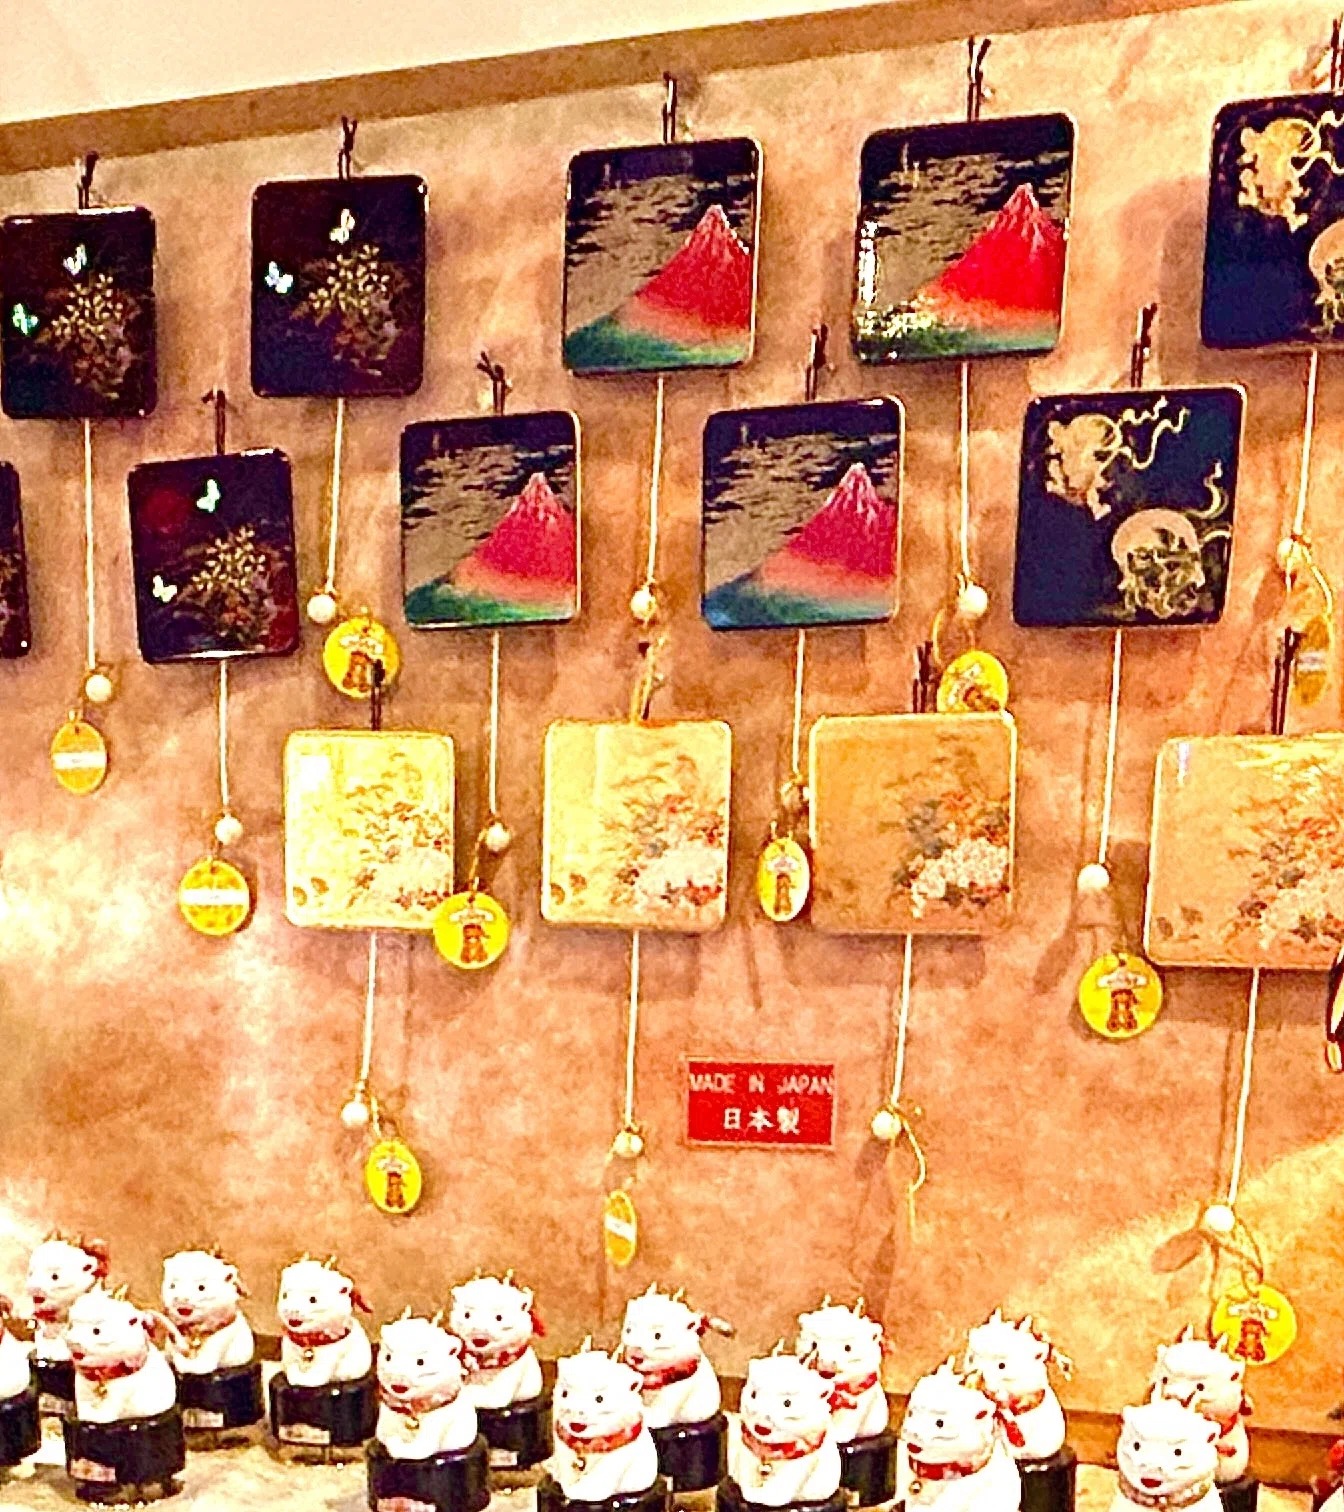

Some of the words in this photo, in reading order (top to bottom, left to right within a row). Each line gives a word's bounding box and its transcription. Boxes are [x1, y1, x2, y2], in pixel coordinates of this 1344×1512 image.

[689, 1072, 736, 1094] MADE
[748, 1072, 765, 1094] IN
[776, 1073, 833, 1096] JAPAN
[723, 1105, 800, 1135] 日本製
